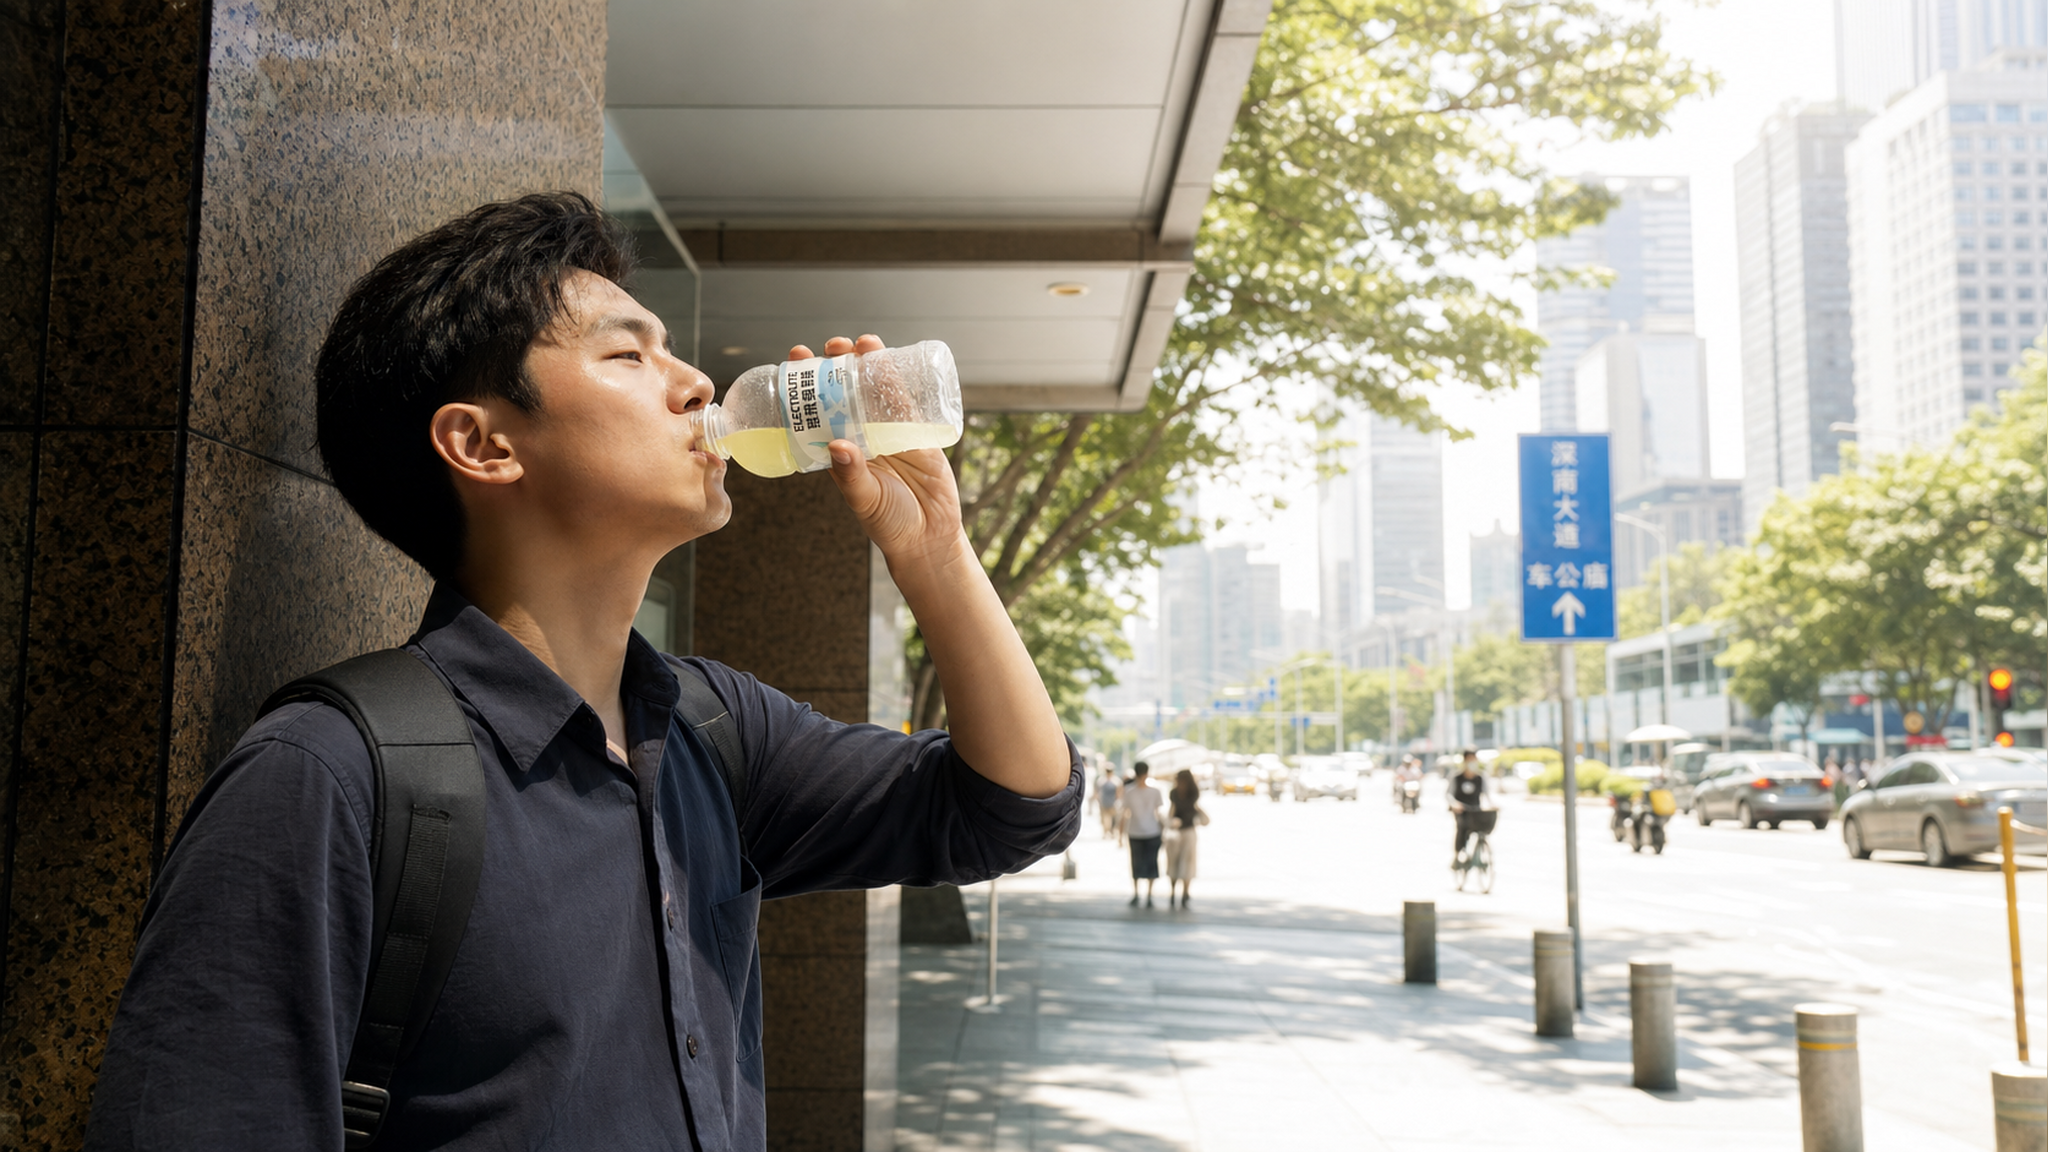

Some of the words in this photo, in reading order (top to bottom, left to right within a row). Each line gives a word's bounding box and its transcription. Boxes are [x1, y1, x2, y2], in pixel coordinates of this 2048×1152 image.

[1551, 440, 1581, 549] 深南大道
[1526, 561, 1609, 590] 车公庙
